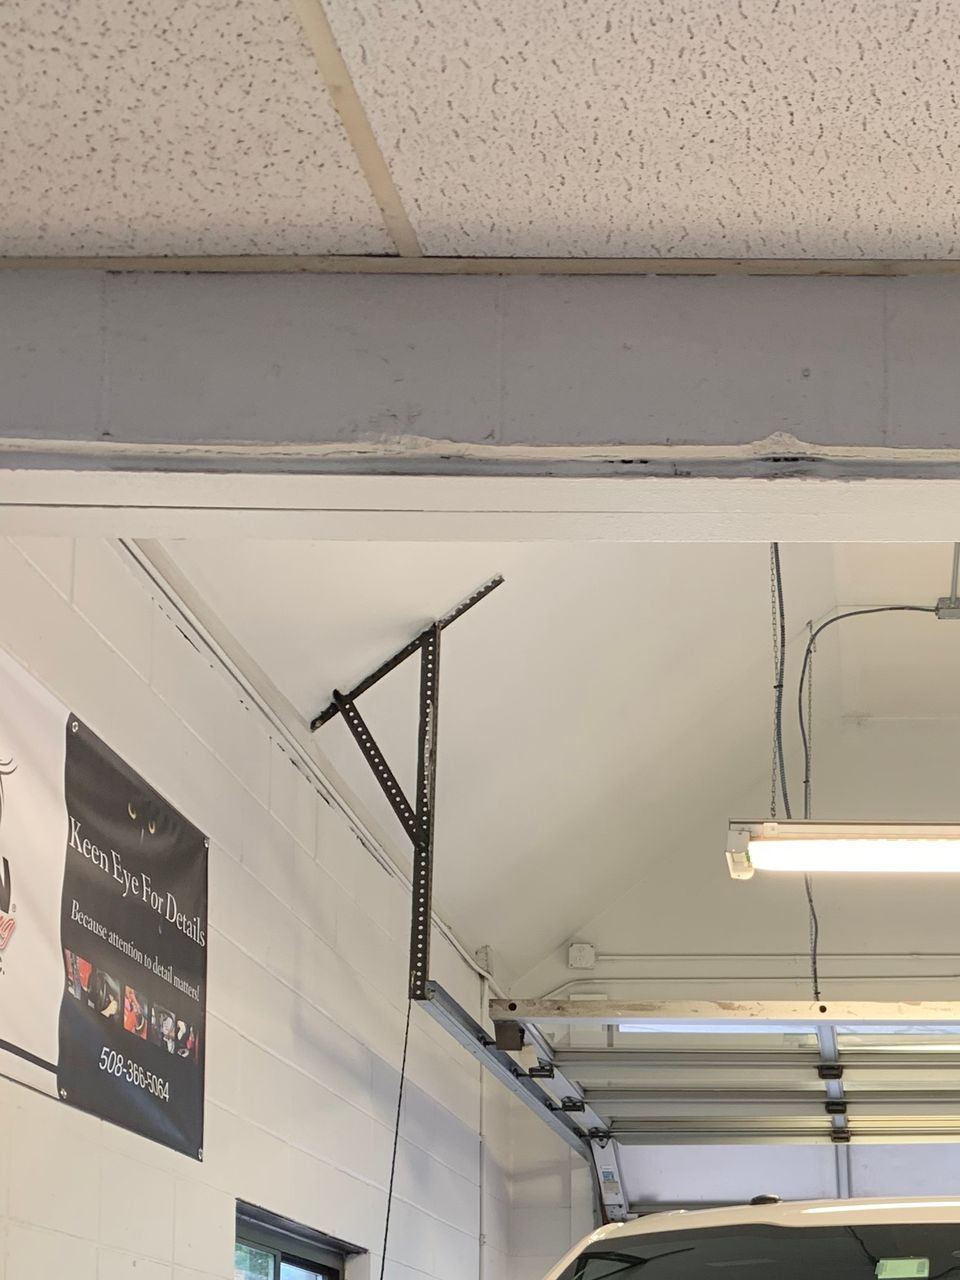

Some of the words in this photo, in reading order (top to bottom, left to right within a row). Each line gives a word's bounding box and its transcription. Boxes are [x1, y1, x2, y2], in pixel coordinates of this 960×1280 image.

[69, 816, 109, 873] Keen
[111, 849, 139, 897] Eye
[141, 872, 164, 914] For
[165, 892, 206, 947] Details
[71, 899, 107, 940] Because
[108, 931, 143, 964] attention
[143, 953, 152, 970] to
[152, 955, 173, 985] detail
[173, 975, 200, 1002] matters!
[99, 1046, 170, 1103] 508-366-5064
